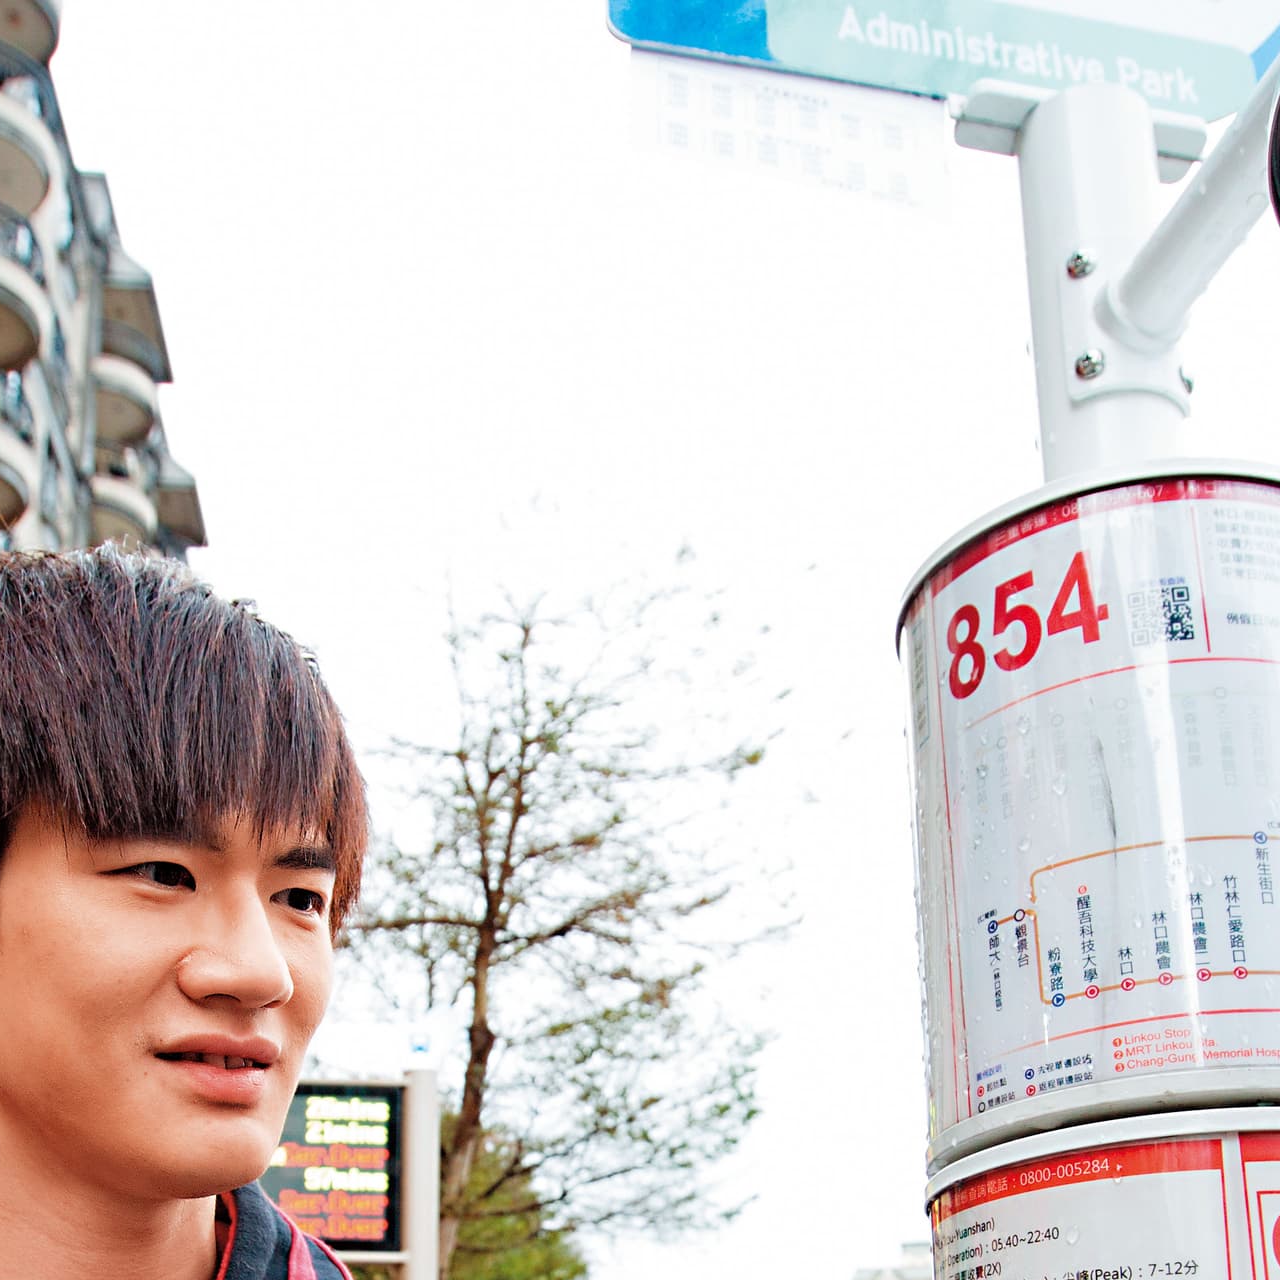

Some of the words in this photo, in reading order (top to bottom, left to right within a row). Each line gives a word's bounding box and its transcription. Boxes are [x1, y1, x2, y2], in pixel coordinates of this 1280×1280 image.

[838, 5, 1105, 83] Administrative
[1117, 56, 1199, 104] Park
[947, 551, 1109, 699] 854
[1256, 847, 1274, 905] 新生街口
[1077, 895, 1099, 982] 醒吾科技大學
[1152, 911, 1172, 970] 林口農會
[1189, 892, 1210, 965] 林口農會二
[1224, 874, 1247, 963] 竹林仁愛路口
[1047, 947, 1065, 991] 粉寮路
[1118, 946, 1134, 975] 林口
[1124, 1031, 1161, 1046] Linkou
[1164, 1028, 1191, 1041] Stop
[1126, 1045, 1152, 1057] MRT
[1155, 1041, 1193, 1054] Linkou
[1203, 1047, 1253, 1061] Memorial
